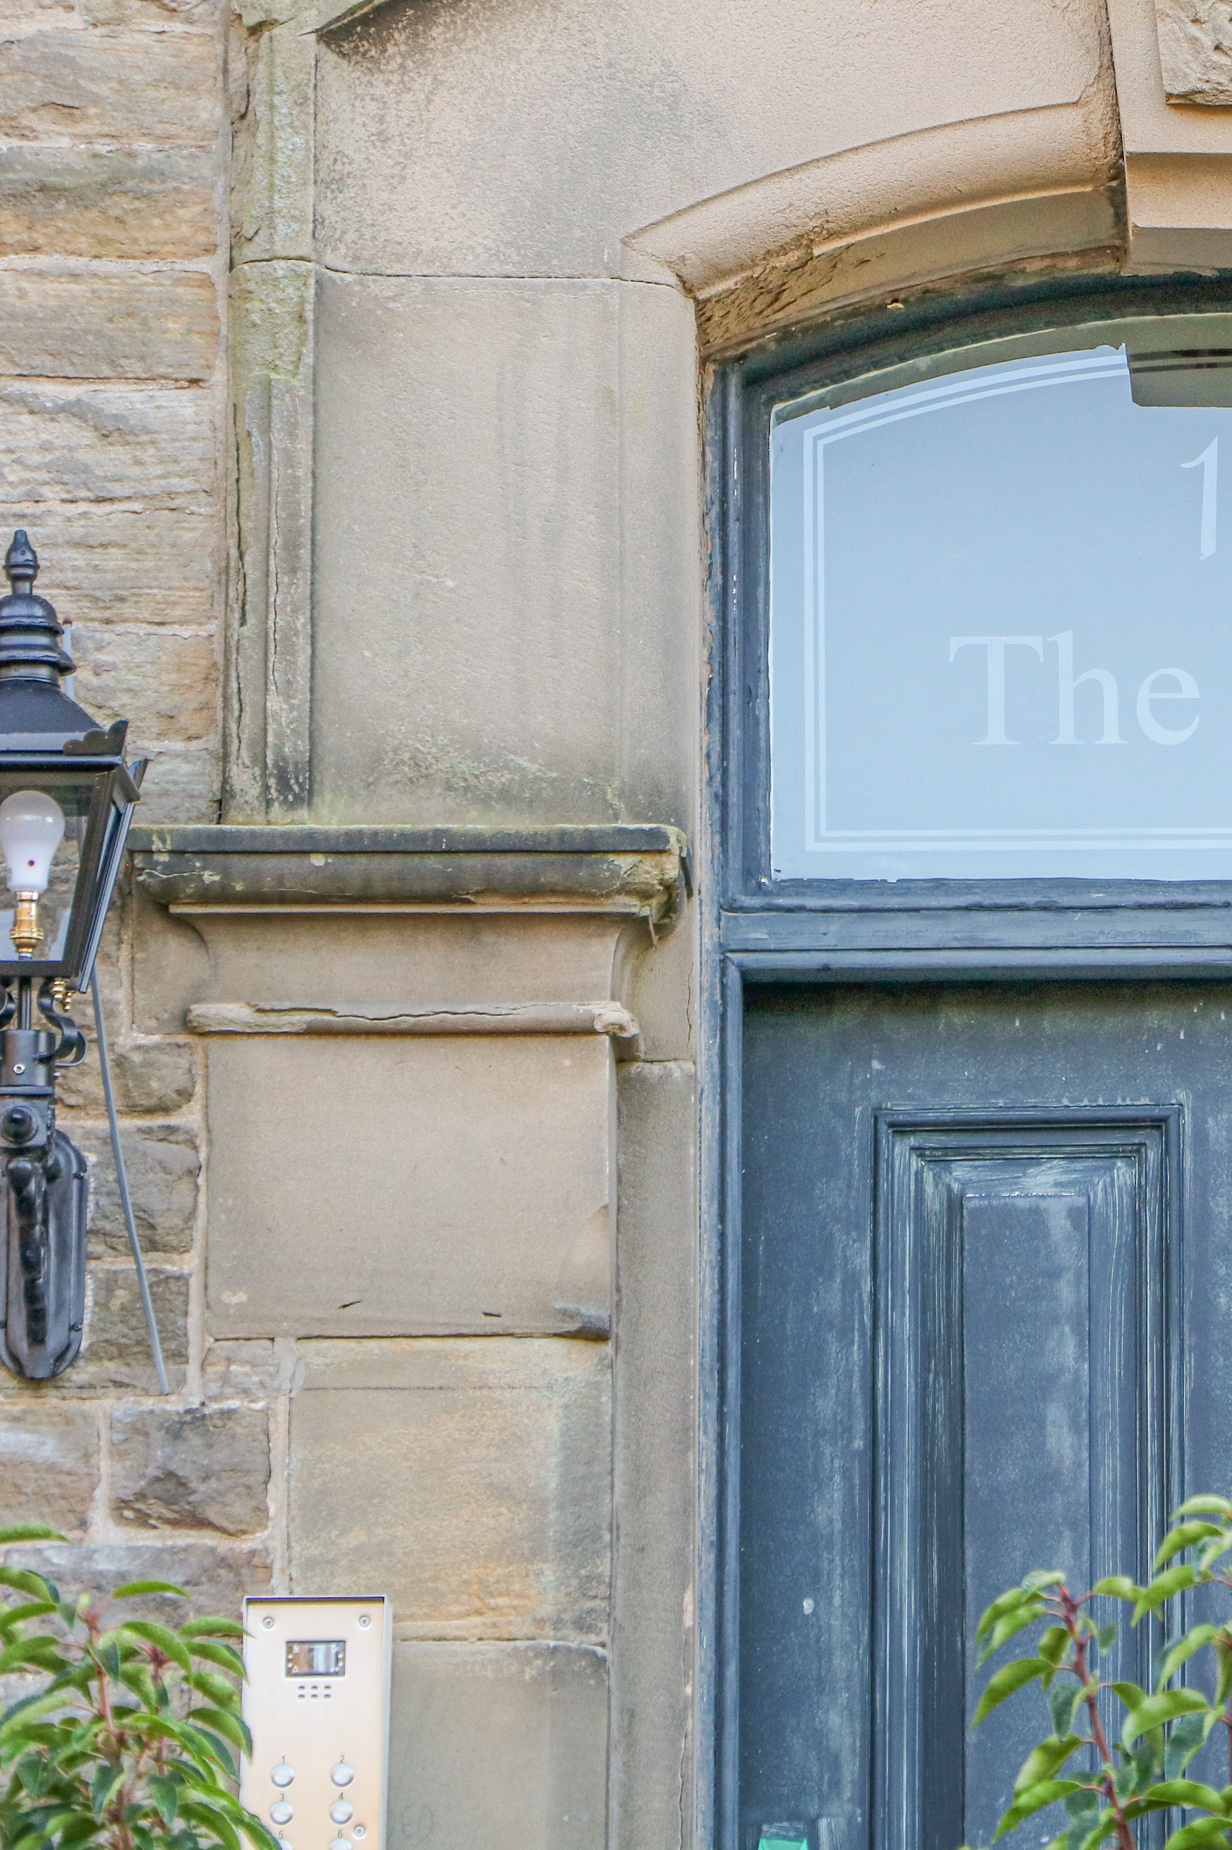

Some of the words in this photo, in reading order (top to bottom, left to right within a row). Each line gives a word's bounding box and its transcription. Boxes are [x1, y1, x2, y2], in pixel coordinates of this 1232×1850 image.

[949, 630, 1201, 746] The
[339, 1754, 345, 1764] 2
[279, 1793, 285, 1802] 3
[338, 1792, 344, 1801] 4
[278, 1830, 284, 1840] 5
[337, 1829, 343, 1839] 6
